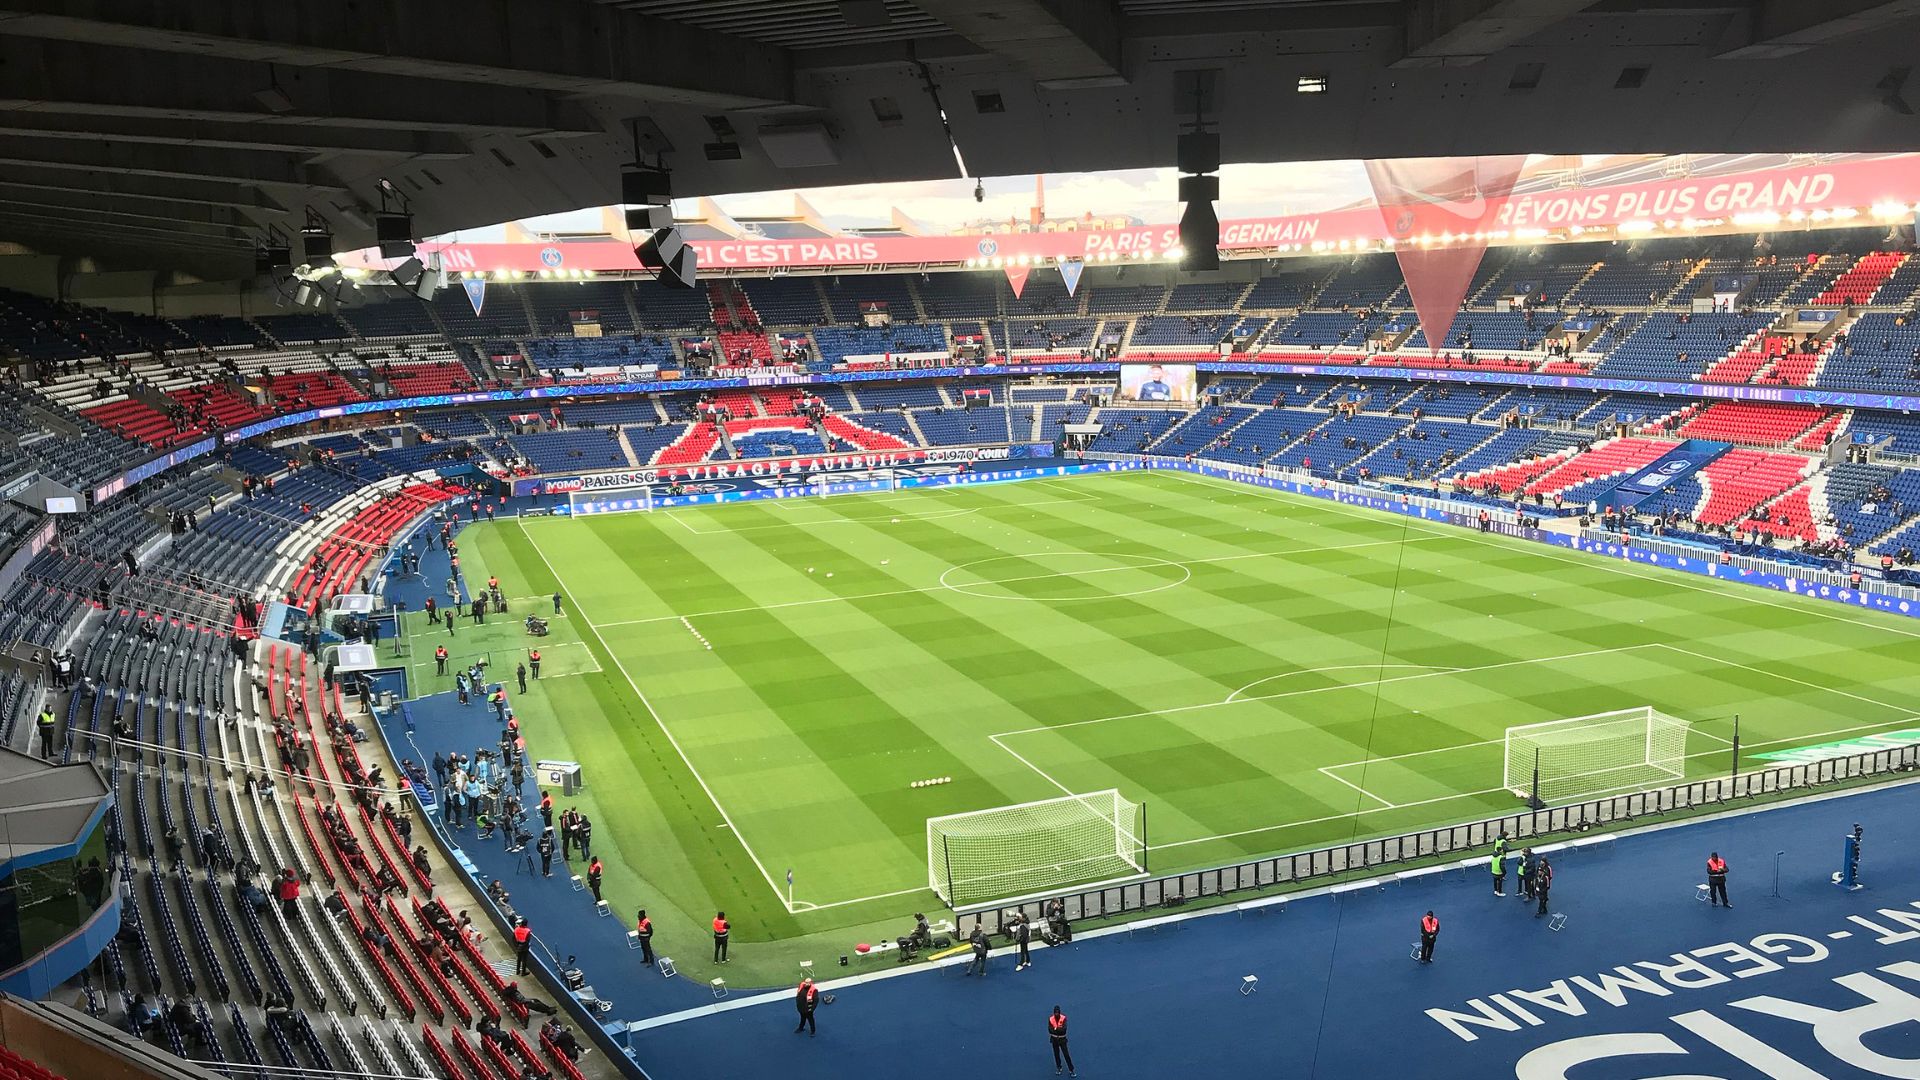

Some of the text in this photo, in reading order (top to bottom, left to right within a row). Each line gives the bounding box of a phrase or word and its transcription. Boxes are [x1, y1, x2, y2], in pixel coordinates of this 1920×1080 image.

[1494, 173, 1835, 225] RÊVONS PLUS GRAND
[1084, 230, 1152, 252] PARIS
[720, 244, 794, 263] C'EST
[801, 242, 878, 261] PARIS
[1703, 386, 1782, 400] COUPE DE FRANCE
[943, 449, 974, 461] 1970
[687, 453, 899, 481] VIRAGE AUTEUIL
[584, 474, 630, 488] PARIS
[634, 472, 656, 483] SG
[1501, 523, 1526, 537] FRANCE
